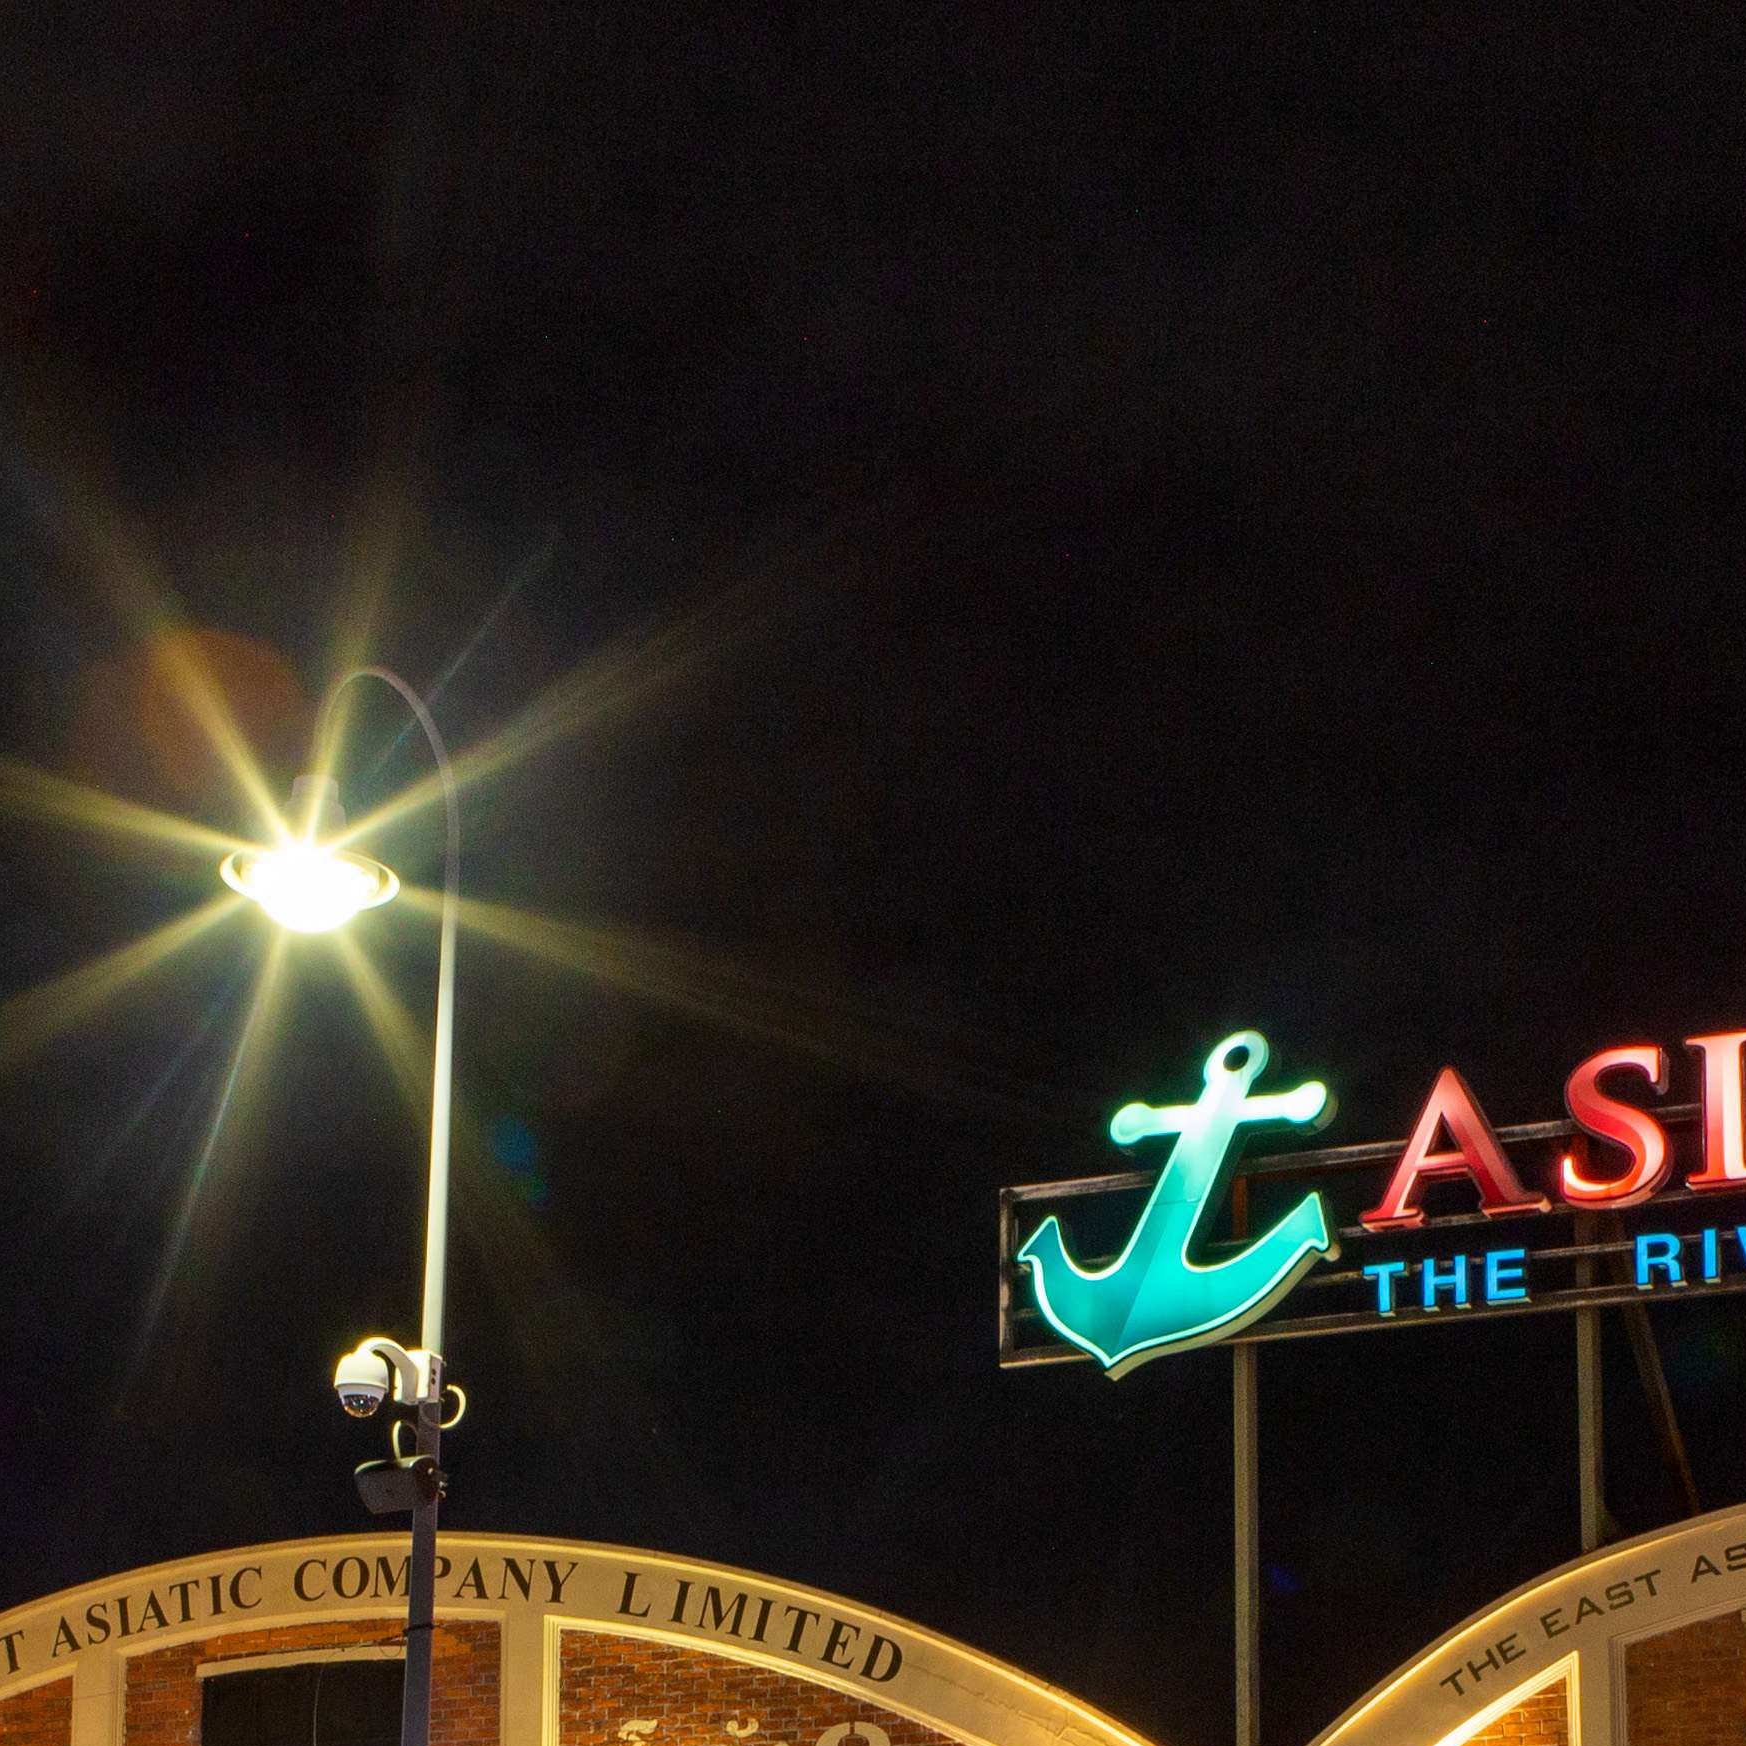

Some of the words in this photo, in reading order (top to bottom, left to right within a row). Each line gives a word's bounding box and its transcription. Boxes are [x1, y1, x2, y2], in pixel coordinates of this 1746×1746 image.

[1363, 1246, 1532, 1317] THE
[51, 1565, 264, 1659] ASIATIC
[615, 1572, 904, 1684] LIMITED
[1440, 1632, 1526, 1698] THE
[1539, 1568, 1661, 1639] EAST
